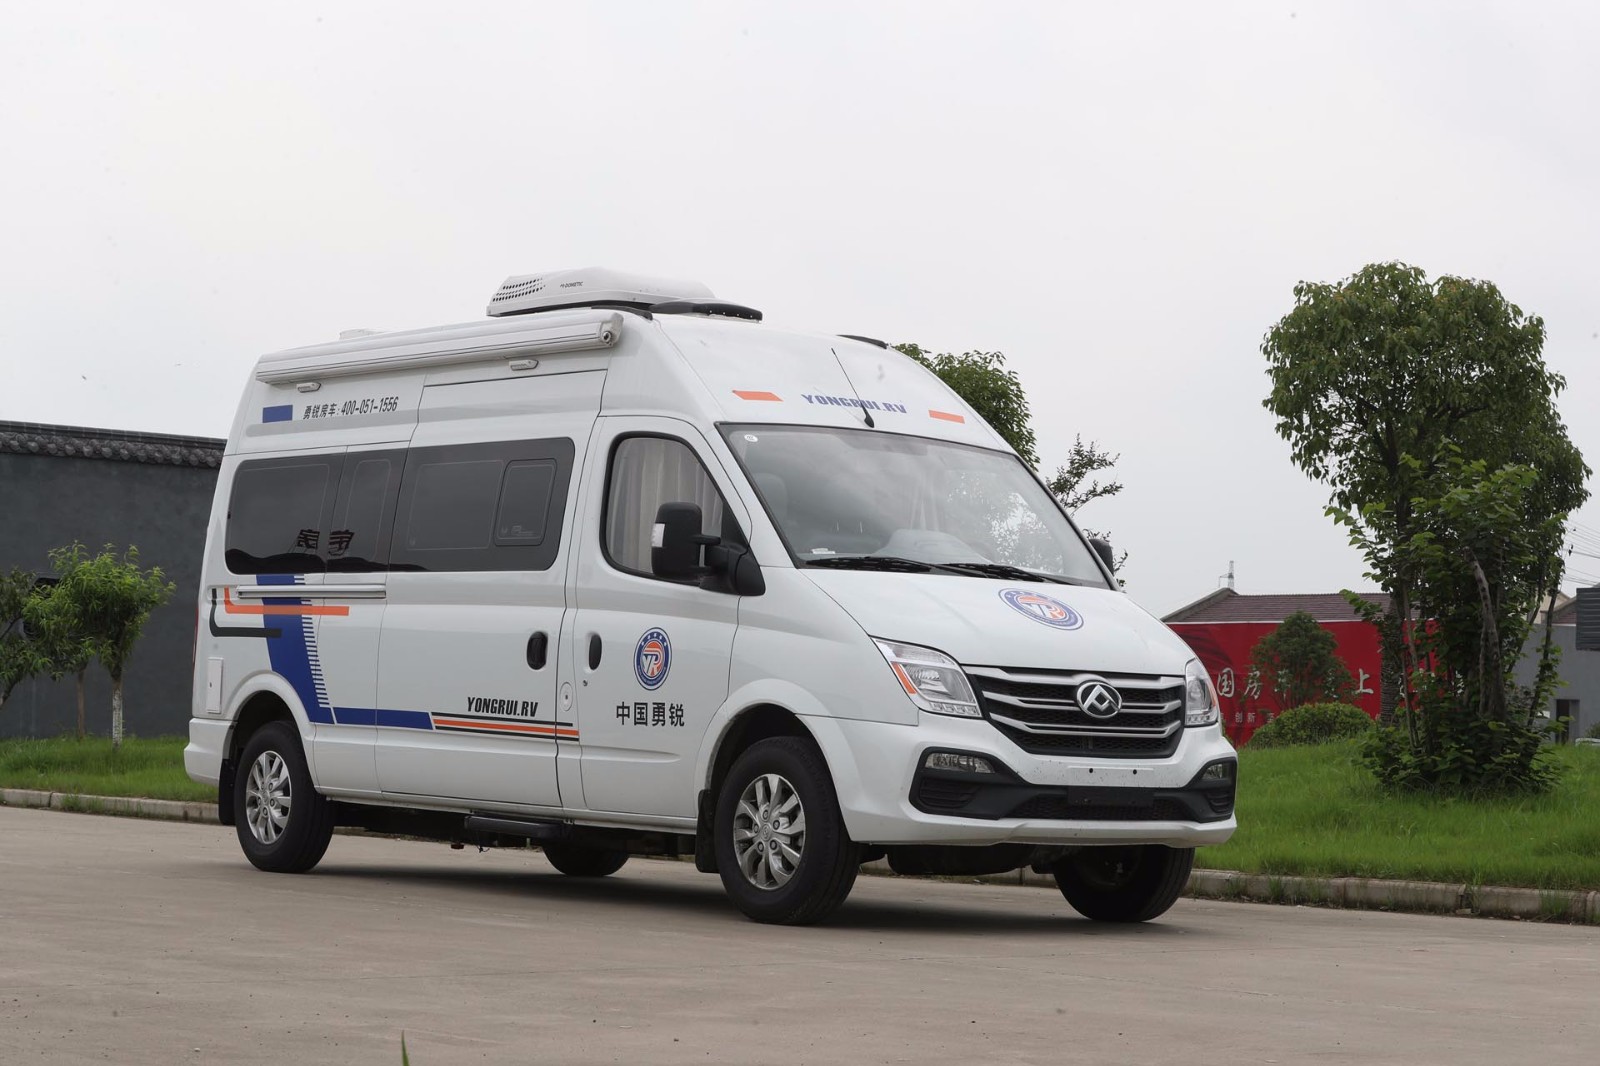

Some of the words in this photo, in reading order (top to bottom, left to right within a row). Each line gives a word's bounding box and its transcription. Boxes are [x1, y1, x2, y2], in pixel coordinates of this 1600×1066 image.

[801, 394, 907, 413] YONGRUI.RV
[467, 697, 538, 717] YONGRUI.RV
[616, 701, 685, 727] 中国勇锐
